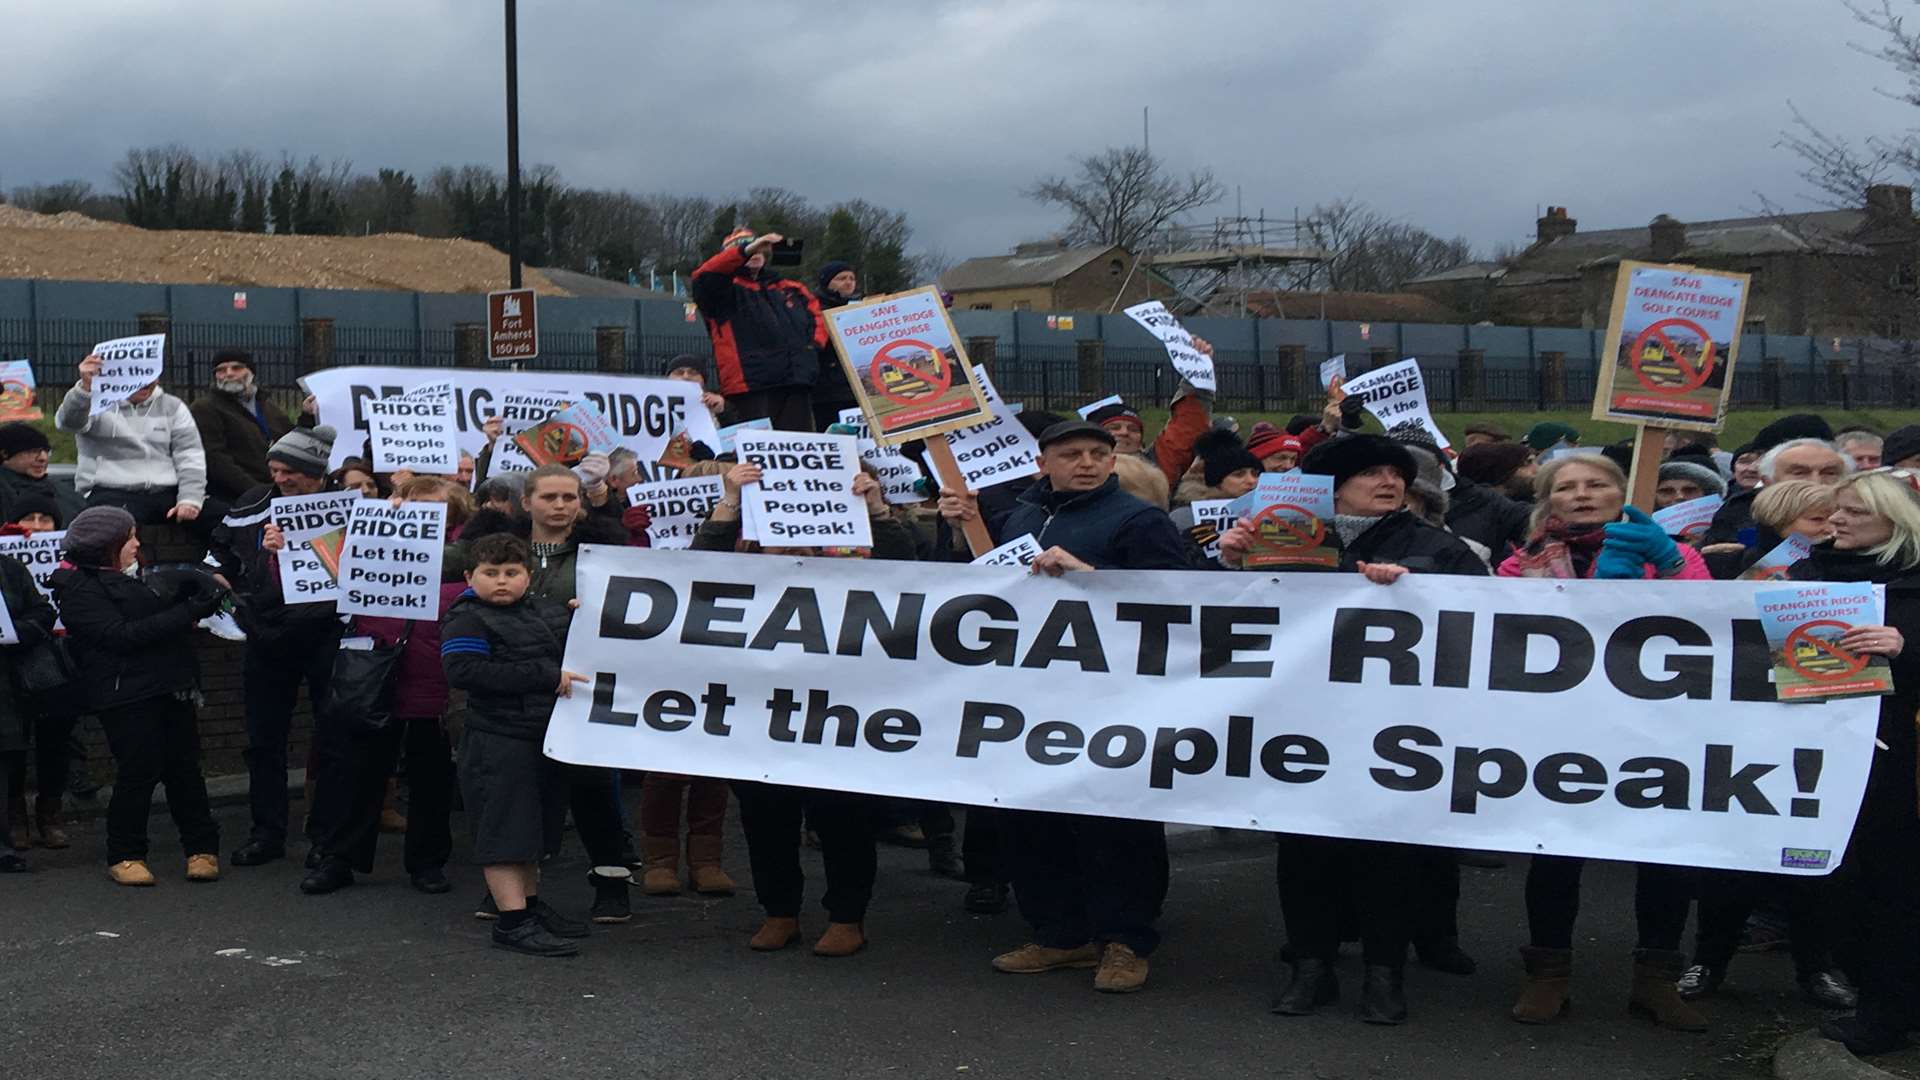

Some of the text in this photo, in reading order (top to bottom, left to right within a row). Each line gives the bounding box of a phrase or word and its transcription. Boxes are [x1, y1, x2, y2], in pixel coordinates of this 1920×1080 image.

[1671, 276, 1703, 288] SAVE
[1633, 287, 1734, 308] DEANGATE RIDGE
[870, 304, 898, 318] SAVE
[1641, 302, 1721, 321] GOLF COURSE
[502, 318, 522, 329] Fort
[843, 309, 936, 336] DEANGATE RIDGE
[493, 329, 533, 342] Amherst
[858, 323, 930, 346] GOLF COURSE
[496, 342, 530, 355] 150 yds
[98, 366, 154, 377] Let the
[1350, 366, 1417, 392] DEANGATE
[372, 403, 446, 416] RIDGE
[1376, 400, 1419, 421] et the
[380, 422, 443, 433] Let the
[382, 437, 445, 450] People
[944, 428, 967, 445] et
[742, 442, 840, 453] DEANGATE
[864, 447, 881, 458] et
[957, 432, 1020, 463] eople
[384, 453, 448, 465] Speak!
[746, 454, 844, 470] RIDGE
[878, 465, 913, 478] ople
[962, 451, 1034, 483] peak!
[635, 483, 720, 501] DEANGATE
[759, 479, 843, 492] Let the
[355, 506, 440, 521] DEANGATE
[765, 501, 848, 516] People
[277, 510, 350, 533] RIDG
[350, 519, 439, 540] RIDGE
[769, 522, 855, 538] Speak!
[0, 539, 61, 551] EANGAT
[288, 540, 311, 551] Le
[352, 545, 430, 563] Let the
[350, 567, 427, 587] People
[295, 579, 337, 594] Spe
[1797, 588, 1828, 598] SAVE
[348, 590, 427, 608] Speak!
[1763, 595, 1869, 613] DEANGATE RIDGE
[1776, 608, 1860, 623] GOLF COURSE
[599, 575, 1280, 678] DEANGATE
[588, 672, 1824, 818] Let the People Speak!
